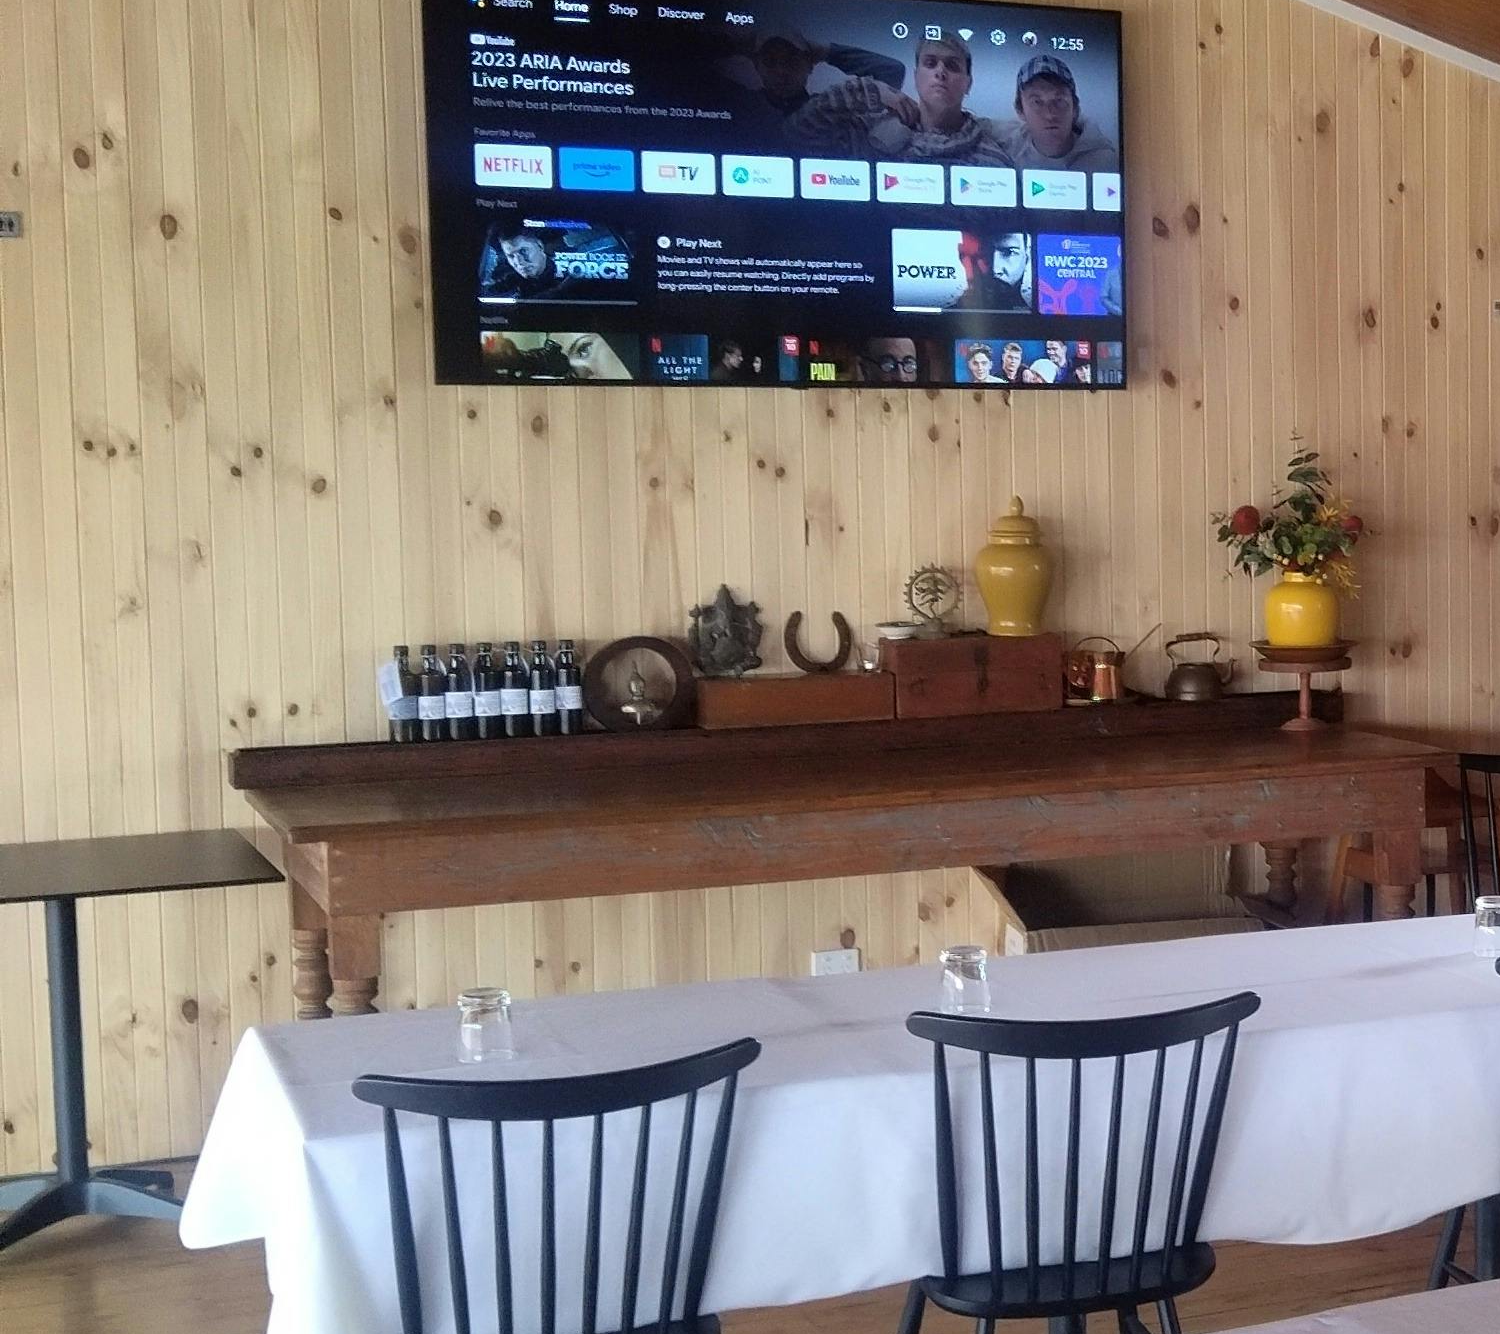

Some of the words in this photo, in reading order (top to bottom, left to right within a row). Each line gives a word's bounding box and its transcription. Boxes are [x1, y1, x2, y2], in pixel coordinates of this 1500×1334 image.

[554, 0, 589, 12] Home
[608, 3, 638, 17] Shop
[657, 6, 705, 21] Discover
[725, 11, 754, 25] Apps
[1050, 37, 1084, 51] 12:55
[471, 51, 515, 67] 2023
[519, 53, 563, 70] ARIA
[565, 56, 631, 74] Awards
[472, 71, 508, 89] Live
[512, 74, 635, 96] Performances
[473, 97, 505, 108] Relive
[506, 99, 524, 109] the
[525, 100, 549, 110] best
[550, 101, 622, 114] performances
[624, 105, 648, 115] from
[650, 107, 668, 117] the
[669, 108, 694, 118] 2023
[695, 109, 732, 120] Awards
[483, 156, 543, 175] NETFLIX
[677, 165, 699, 181] TV
[828, 174, 860, 186] YouTube
[476, 198, 496, 209] Play
[497, 199, 518, 209] Next
[676, 238, 697, 250] Play
[699, 239, 722, 249] Next
[555, 252, 587, 261] POWER
[657, 255, 686, 264] Movies
[687, 256, 702, 264] and
[703, 256, 715, 265] TV
[715, 257, 740, 266] shows
[755, 258, 806, 269] automatically
[806, 260, 833, 270] appear
[834, 260, 852, 269] here
[1044, 255, 1075, 268] RWC
[1077, 256, 1108, 268] 2023
[555, 262, 629, 280] FORCE
[657, 270, 673, 279] you
[673, 270, 689, 278] can
[689, 270, 712, 280] easily
[713, 271, 742, 279] resume
[780, 272, 811, 283] Directly
[811, 273, 827, 282] add
[827, 274, 865, 284] programs
[864, 275, 875, 284] by
[896, 264, 957, 279] POWER
[1056, 268, 1097, 279] CENTRAL
[657, 281, 713, 294] long-pressing
[713, 283, 727, 292] the
[727, 284, 753, 292] center
[753, 285, 780, 293] button
[791, 286, 809, 295] your
[809, 287, 840, 295] remote.
[651, 338, 662, 354] N
[657, 356, 678, 365] ALL
[681, 356, 703, 365] THE
[663, 366, 698, 375] LIGHT
